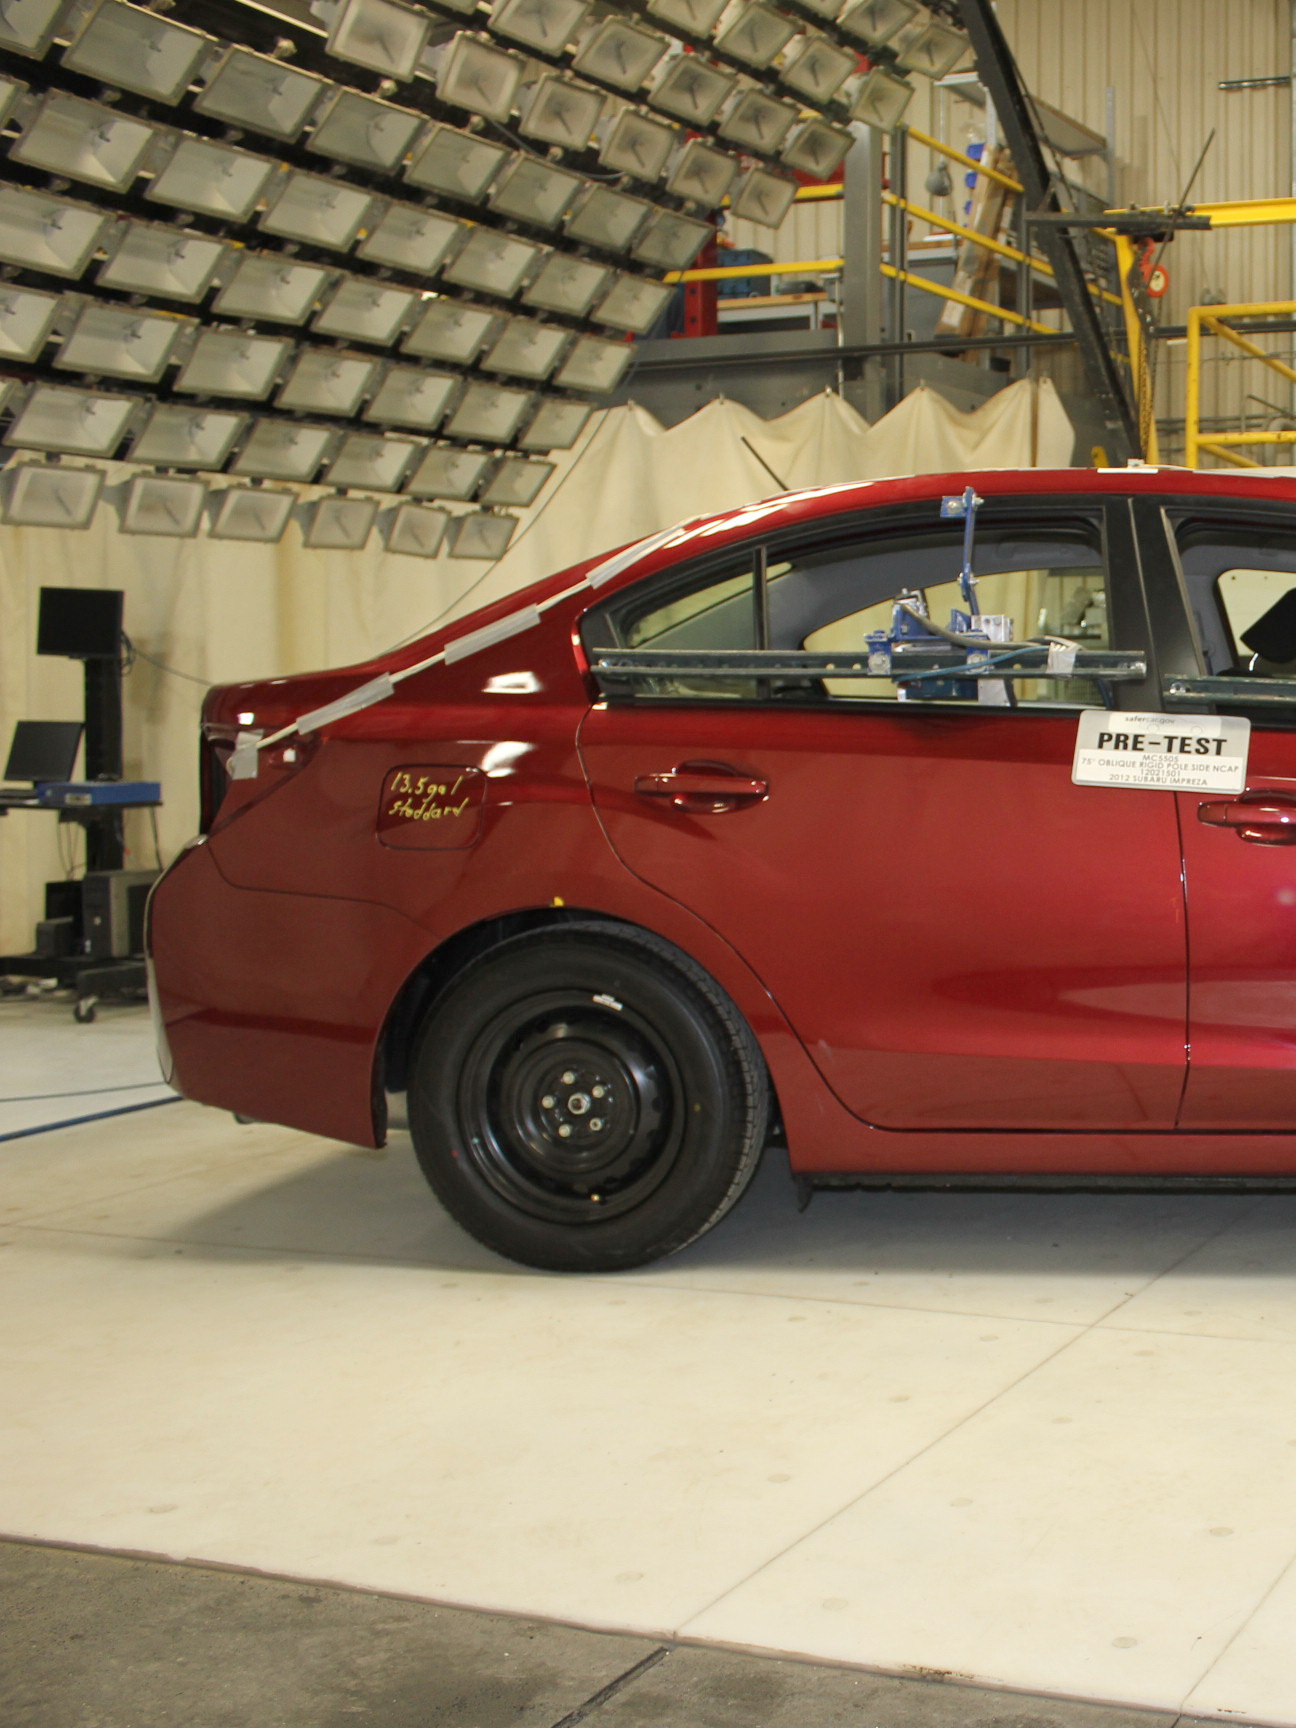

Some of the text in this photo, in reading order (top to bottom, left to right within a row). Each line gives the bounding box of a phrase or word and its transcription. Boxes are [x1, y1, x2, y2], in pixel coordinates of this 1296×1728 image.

[1097, 732, 1227, 756] PRE-TEST
[1142, 754, 1179, 763] MC5505
[1098, 758, 1136, 769] OBLIQUE
[1139, 761, 1164, 770] RIGID
[1166, 762, 1189, 771] POLE
[1191, 764, 1210, 772] SIDE
[1212, 765, 1239, 773] NCAP
[1140, 768, 1181, 777] 12021501
[1109, 774, 1208, 786] 2012 SUBARU IMPREZA
